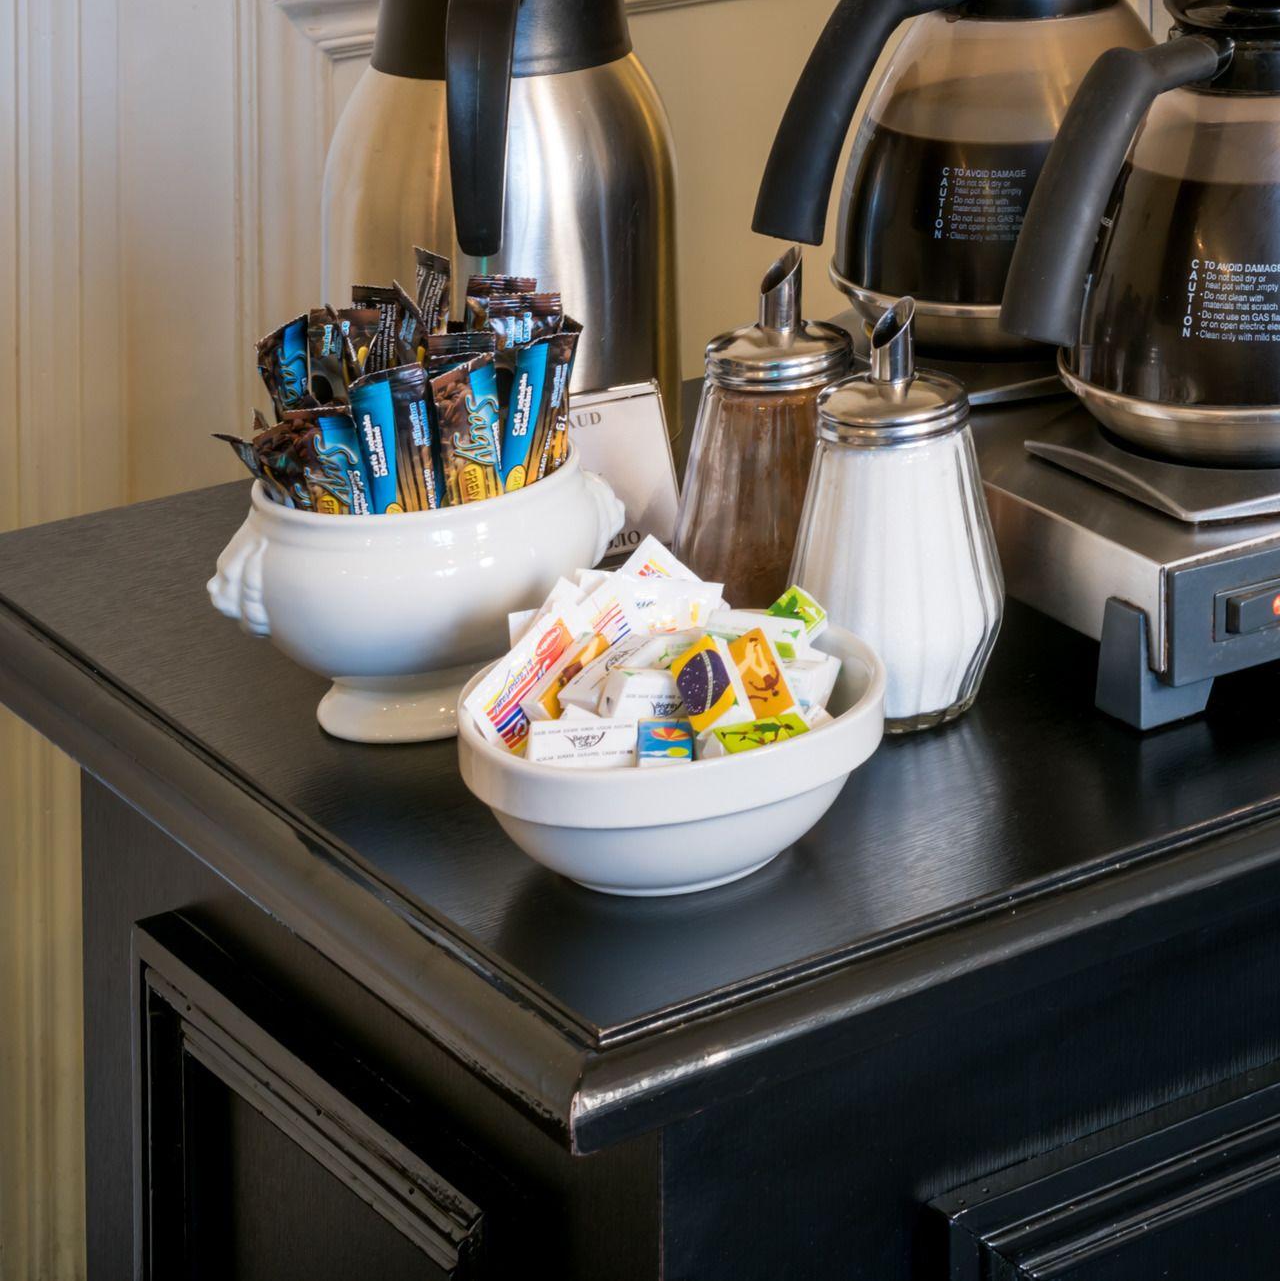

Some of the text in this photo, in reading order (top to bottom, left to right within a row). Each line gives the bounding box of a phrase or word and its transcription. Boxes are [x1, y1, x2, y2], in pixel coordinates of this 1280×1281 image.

[953, 168, 1027, 178] TO AVOID DAMAGE
[1204, 260, 1215, 270] TO
[1217, 262, 1243, 272] AVOID
[1206, 272, 1216, 280] Do
[1218, 272, 1230, 281] not
[1245, 274, 1257, 284] dry
[1258, 275, 1266, 283] or
[1205, 280, 1220, 289] heat
[1222, 283, 1233, 291] pot
[1235, 282, 1254, 290] when
[1204, 291, 1264, 302] Do not clean with
[1202, 300, 1278, 311] materials that scratch
[1201, 310, 1212, 319] Do
[1213, 311, 1225, 320] not
[1226, 312, 1239, 320] use
[1240, 313, 1250, 321] on
[1252, 313, 1269, 322] GAS
[1210, 321, 1218, 329] on
[1220, 322, 1237, 331] open
[1239, 321, 1265, 331] electric
[1200, 329, 1220, 339] Clean
[1221, 331, 1236, 342] only
[1238, 332, 1253, 341] with
[1254, 332, 1270, 341] mild
[517, 372, 528, 410] soluble
[363, 414, 376, 452] soluble
[454, 394, 500, 467] Sagy
